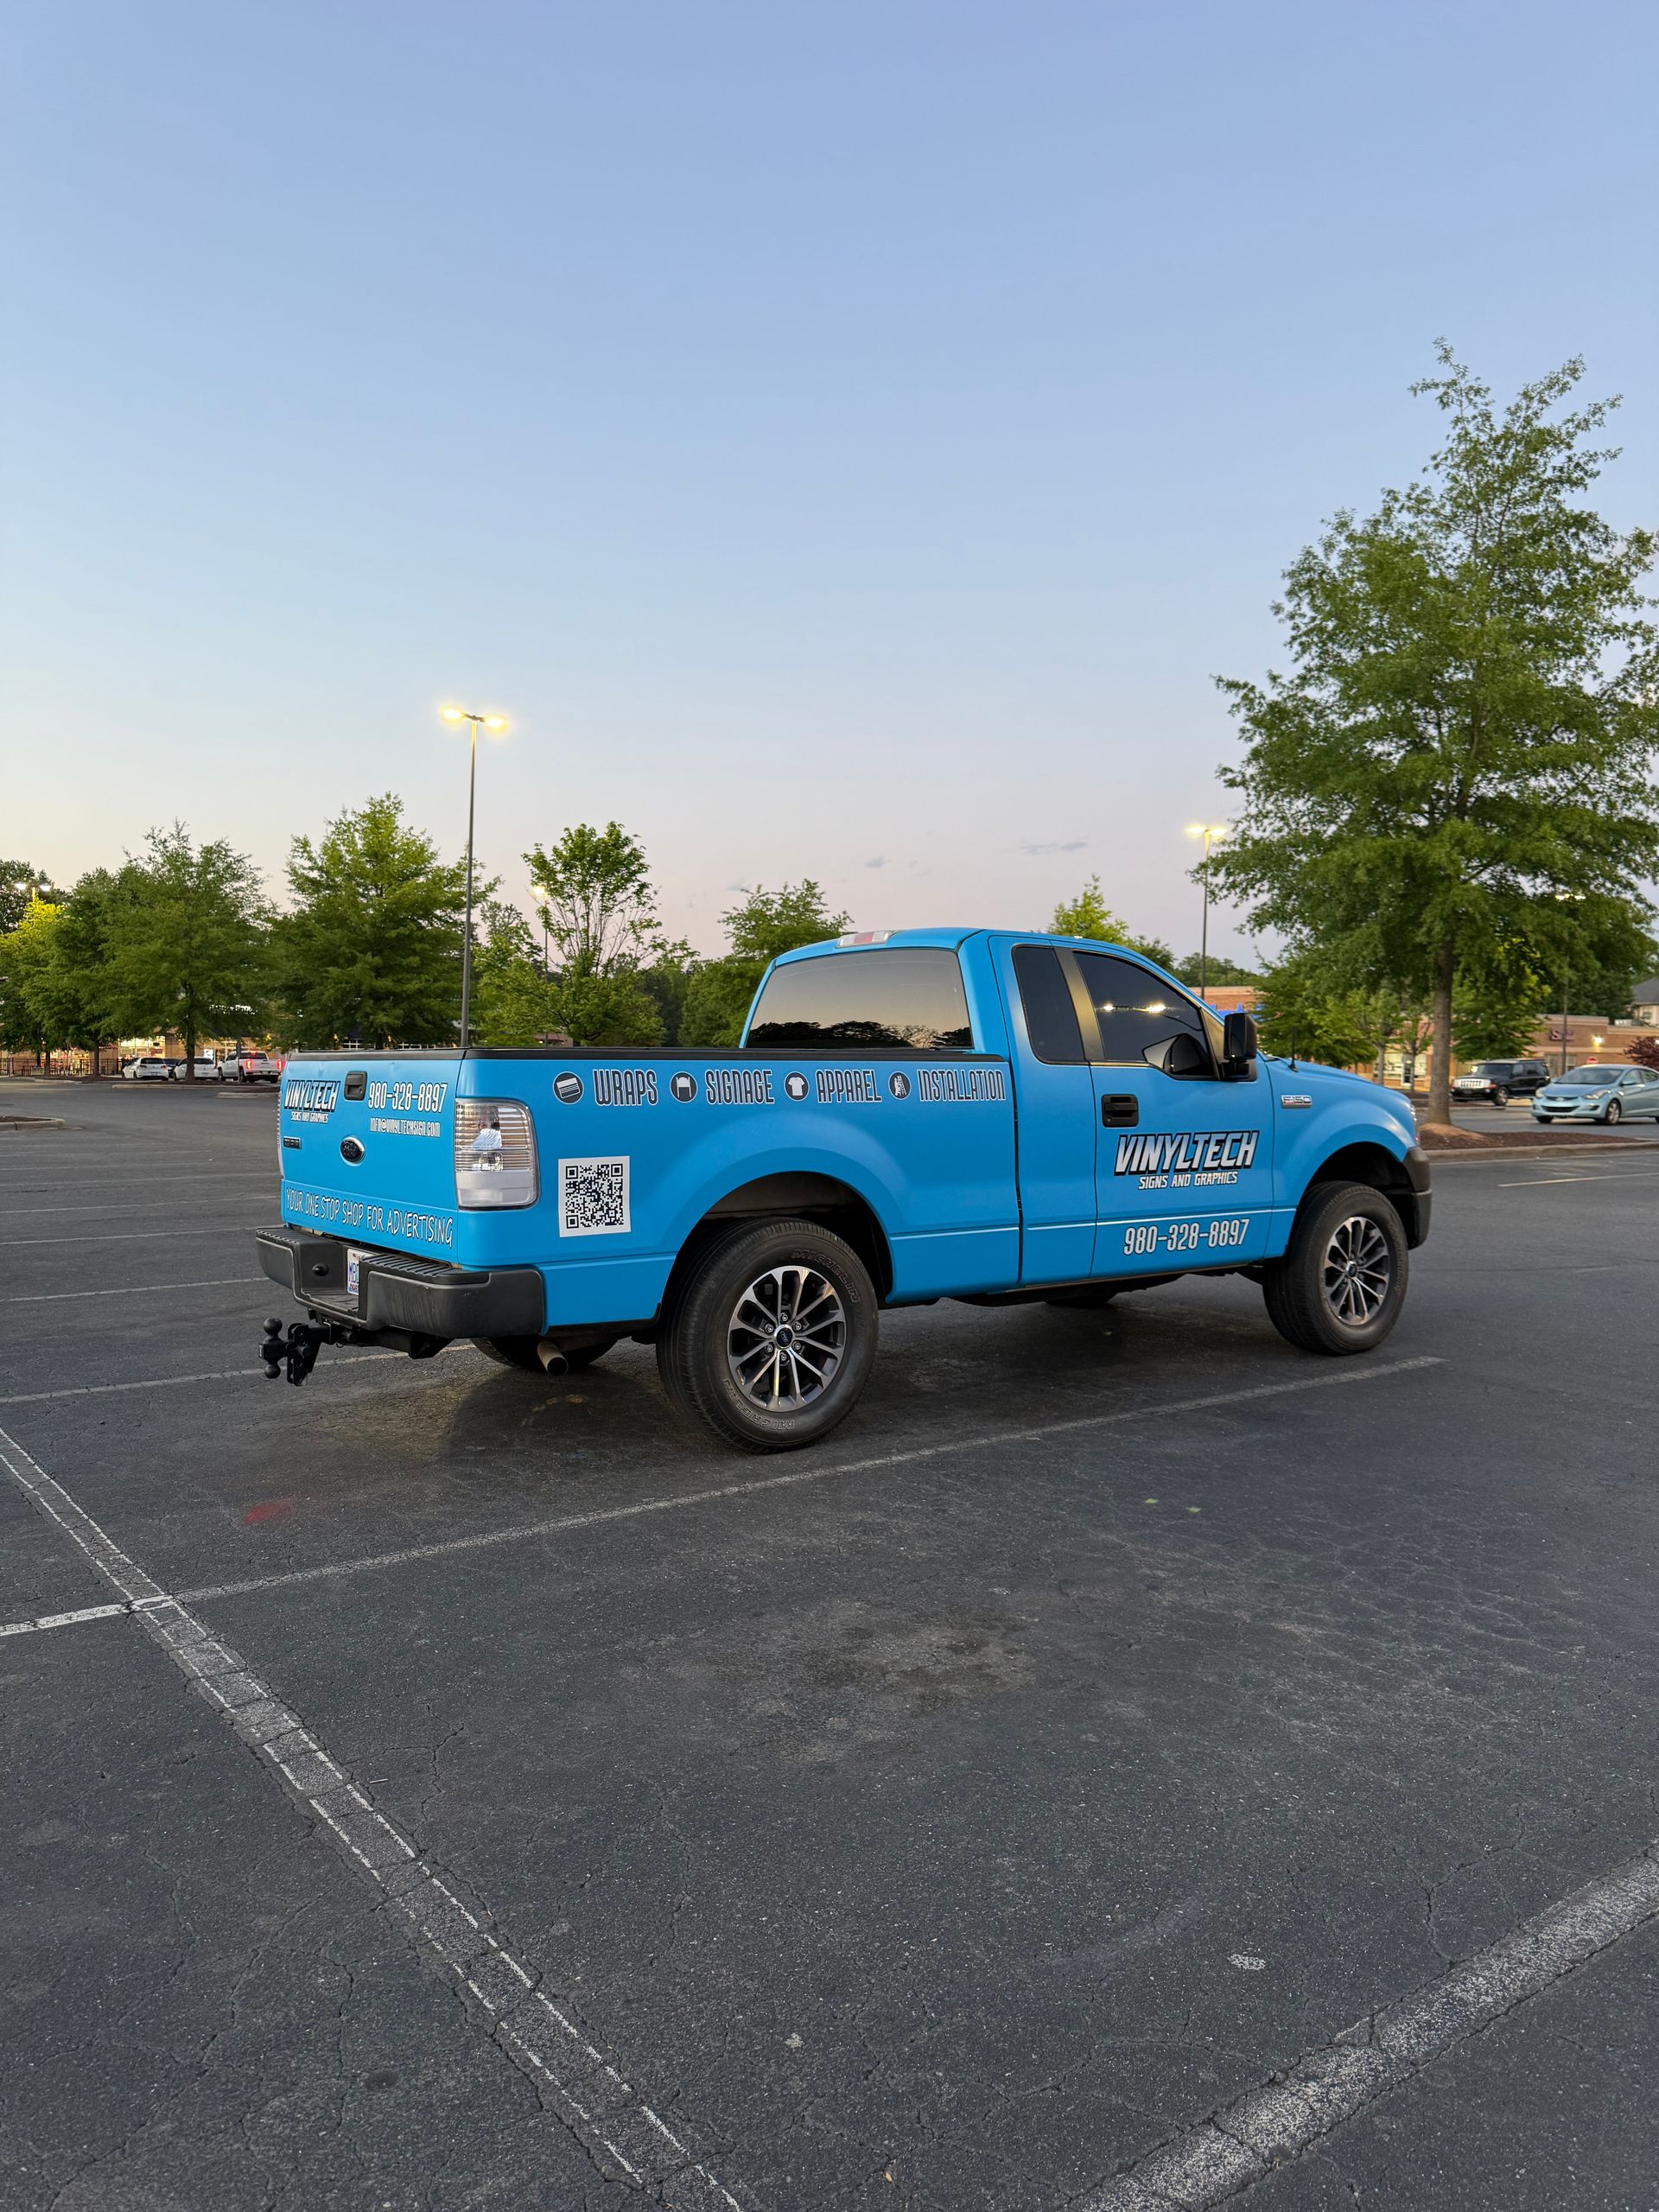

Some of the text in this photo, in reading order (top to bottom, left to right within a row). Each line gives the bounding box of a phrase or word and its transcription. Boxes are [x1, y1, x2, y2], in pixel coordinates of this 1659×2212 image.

[283, 1080, 340, 1112] VINYLTECH
[367, 1081, 448, 1113] 980-328-8897
[593, 1069, 1006, 1106] WRAPS SIGNAGE APPAREL INSTALLATION
[1114, 1130, 1260, 1175] VINYLTECH
[1137, 1171, 1238, 1190] SIGNS AND GRAPHICS
[286, 1188, 453, 1249] YOUR ONE STOP SHOP FOR ADVERTISING
[1123, 1218, 1249, 1255] 980-328-8897
[722, 1377, 795, 1431] MICHELIN
